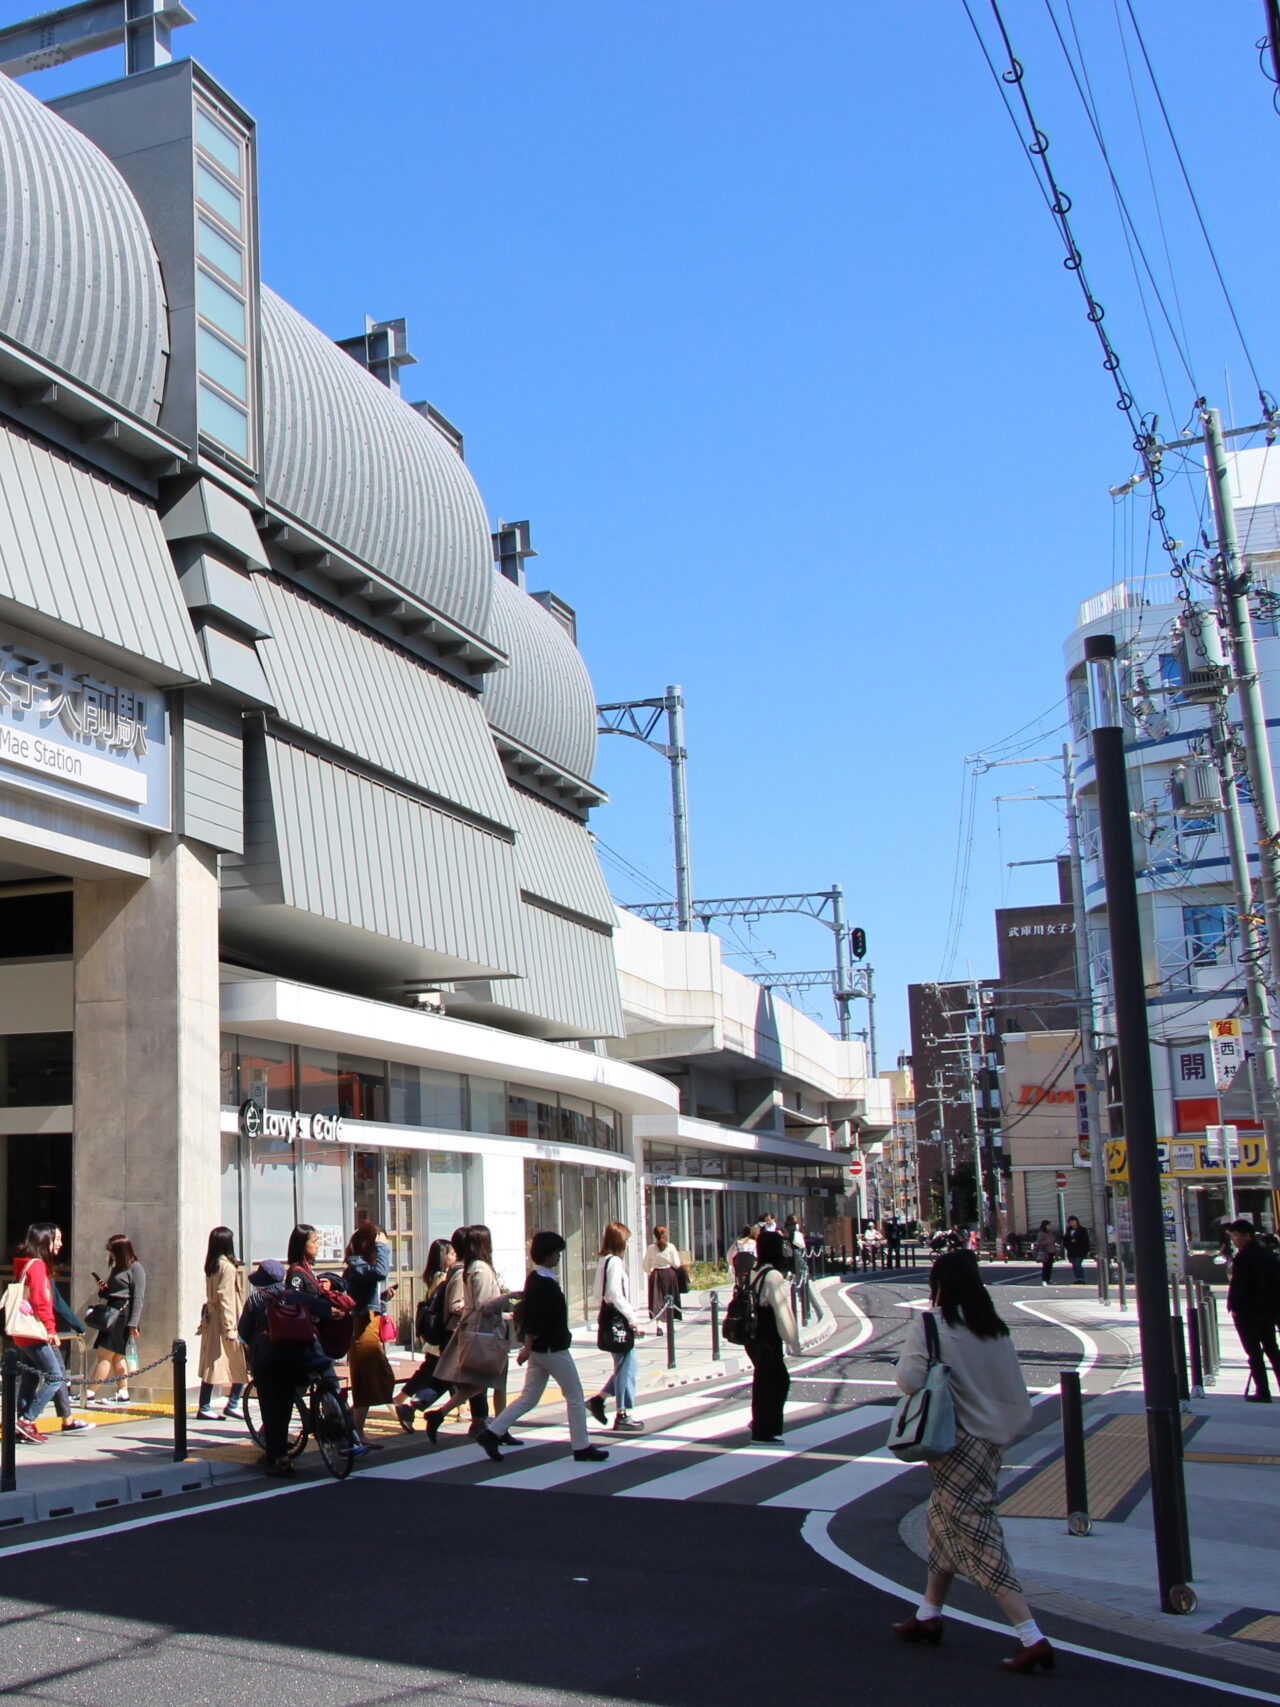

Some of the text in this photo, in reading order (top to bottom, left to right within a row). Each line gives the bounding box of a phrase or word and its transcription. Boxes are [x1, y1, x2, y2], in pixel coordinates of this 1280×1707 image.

[33, 738, 83, 777] Station
[1215, 1020, 1234, 1037] 質
[262, 1107, 345, 1144] Lavy's Café
